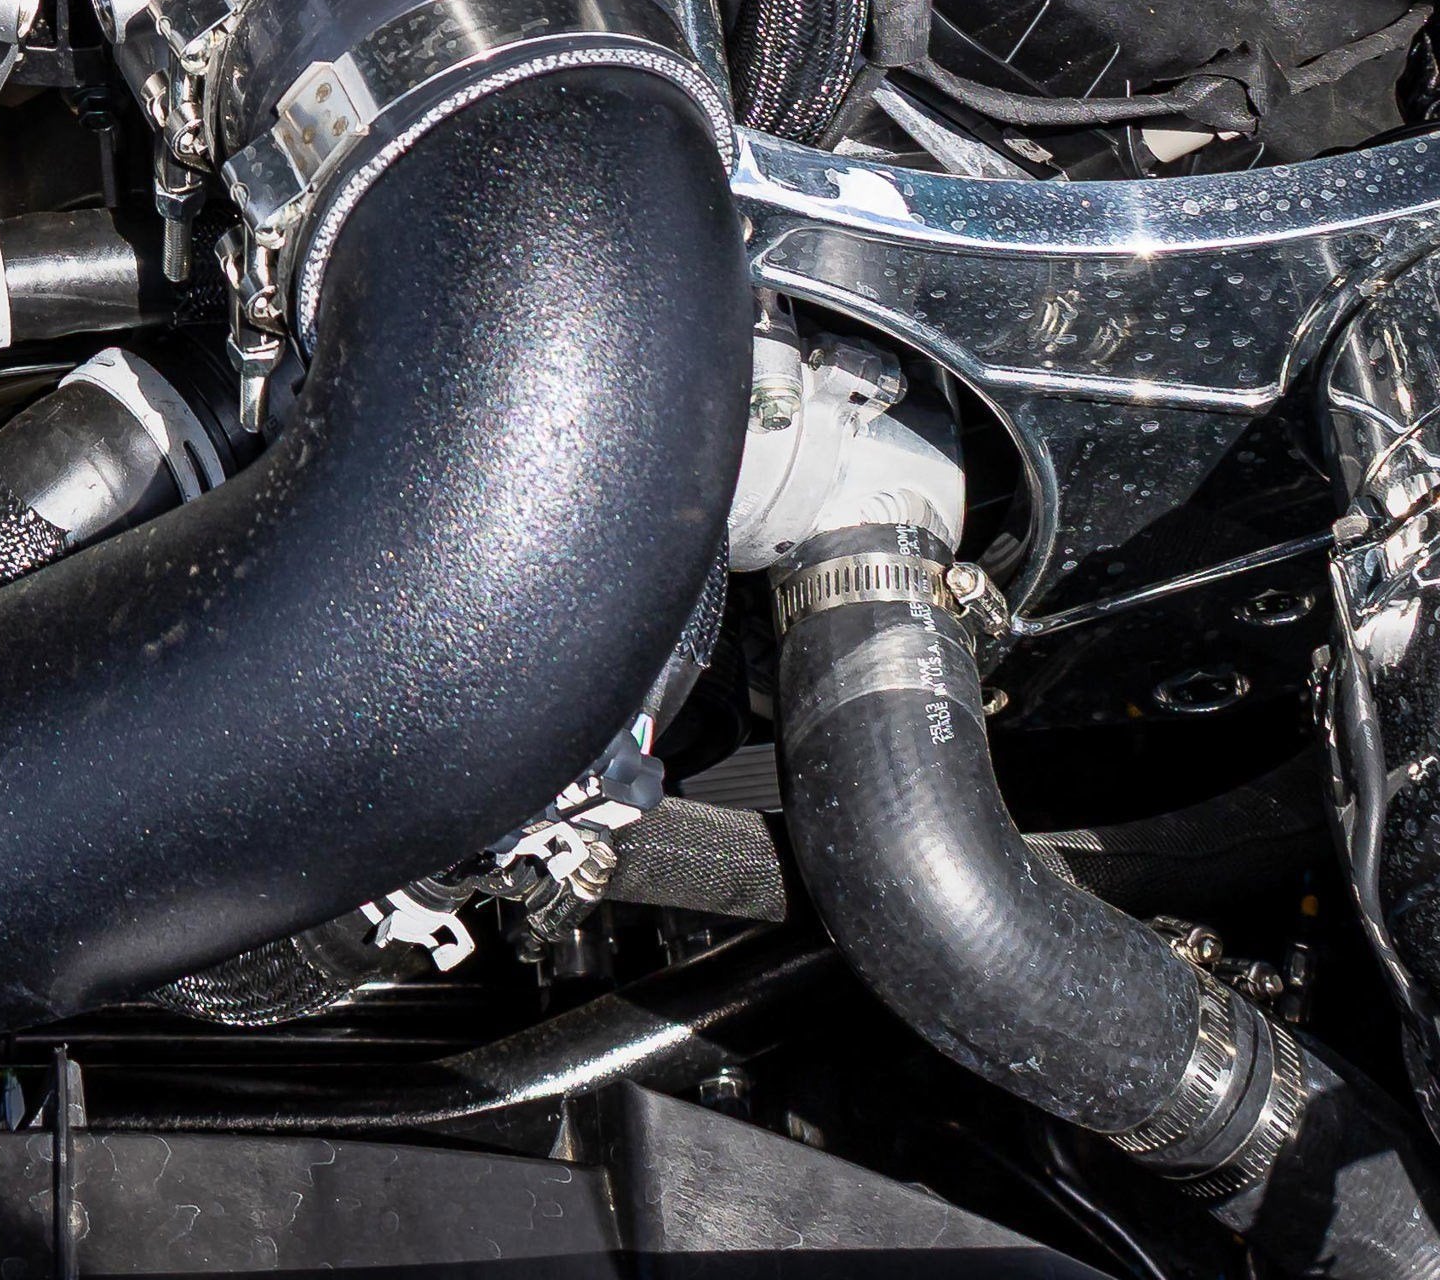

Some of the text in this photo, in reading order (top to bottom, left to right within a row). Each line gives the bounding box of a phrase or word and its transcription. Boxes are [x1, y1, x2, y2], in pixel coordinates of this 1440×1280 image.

[922, 603, 937, 631] MAD
[925, 703, 946, 745] 25L13
[938, 701, 954, 741] MADE
